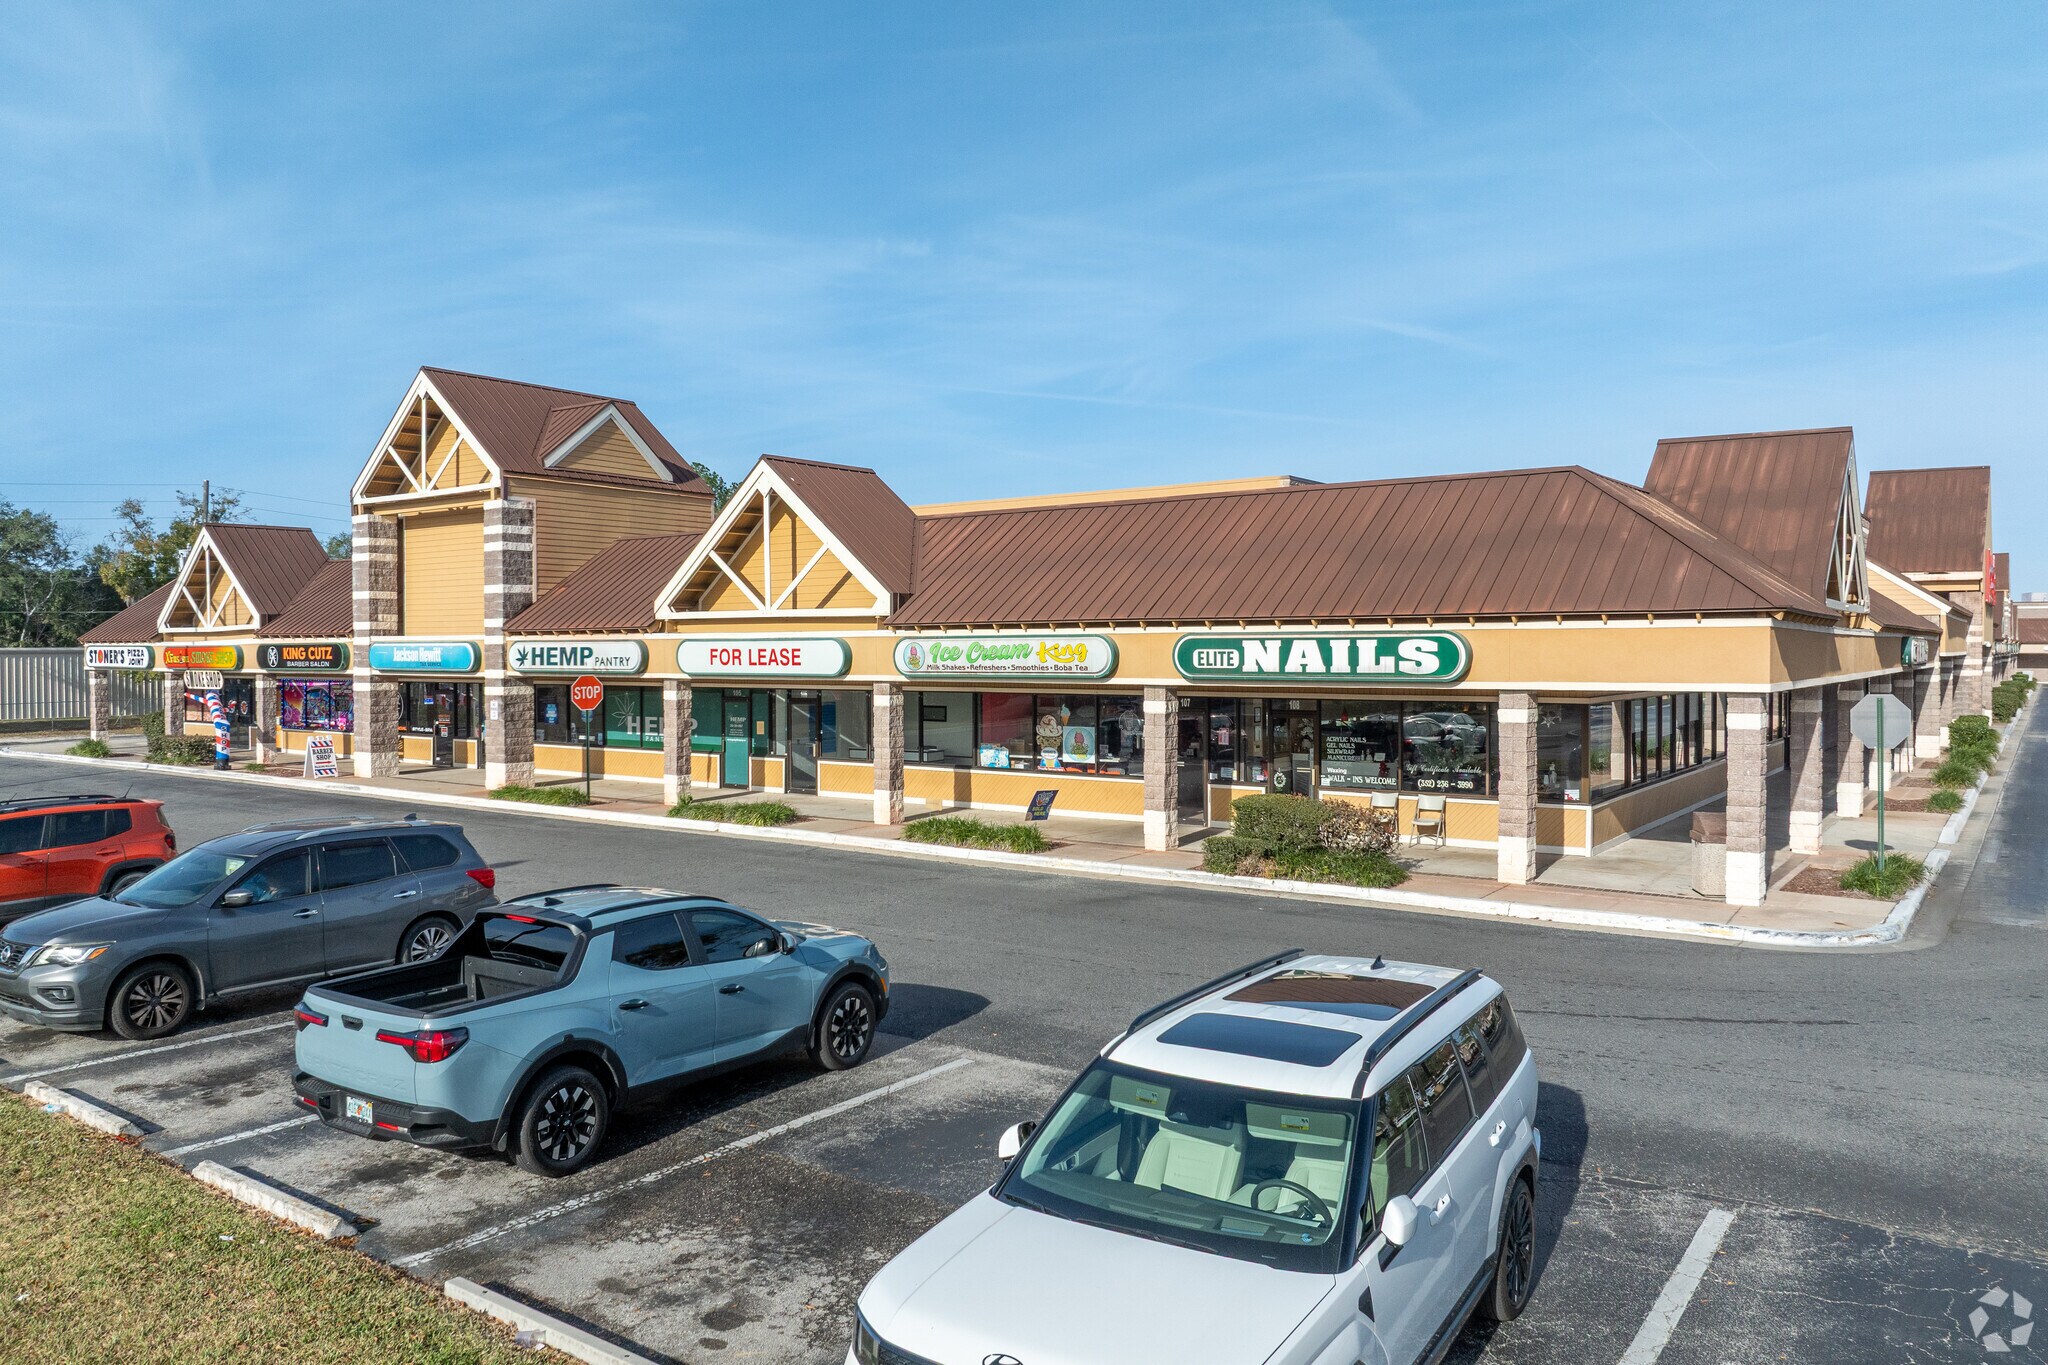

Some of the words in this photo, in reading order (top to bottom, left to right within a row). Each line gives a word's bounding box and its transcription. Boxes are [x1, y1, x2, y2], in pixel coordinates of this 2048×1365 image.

[89, 649, 125, 664] STONER'S
[127, 649, 144, 657] PIZZA
[282, 647, 306, 660] KING
[308, 646, 333, 660] CUTZ
[393, 647, 419, 662] Jackson
[419, 647, 441, 662] Hewitt
[531, 646, 593, 666] HEMP
[595, 656, 630, 666] PANTRY
[710, 648, 742, 665] FOR
[748, 648, 801, 666] LEASE
[929, 642, 963, 663] Ice
[966, 641, 1033, 663] Cream
[1036, 641, 1088, 663] King
[1197, 650, 1235, 667] ELITE
[1242, 638, 1440, 675] NAILS
[128, 658, 144, 666] JOINT
[205, 671, 221, 688] SHOP
[574, 685, 601, 700] STOP
[1180, 698, 1191, 707] 107
[627, 716, 698, 736] HEP
[1326, 767, 1348, 775] Waxing
[1420, 763, 1450, 775] Certificate
[1452, 765, 1482, 774] Available
[1352, 776, 1364, 784] INS
[1364, 776, 1397, 785] WELCOME
[1417, 778, 1436, 788] (352)
